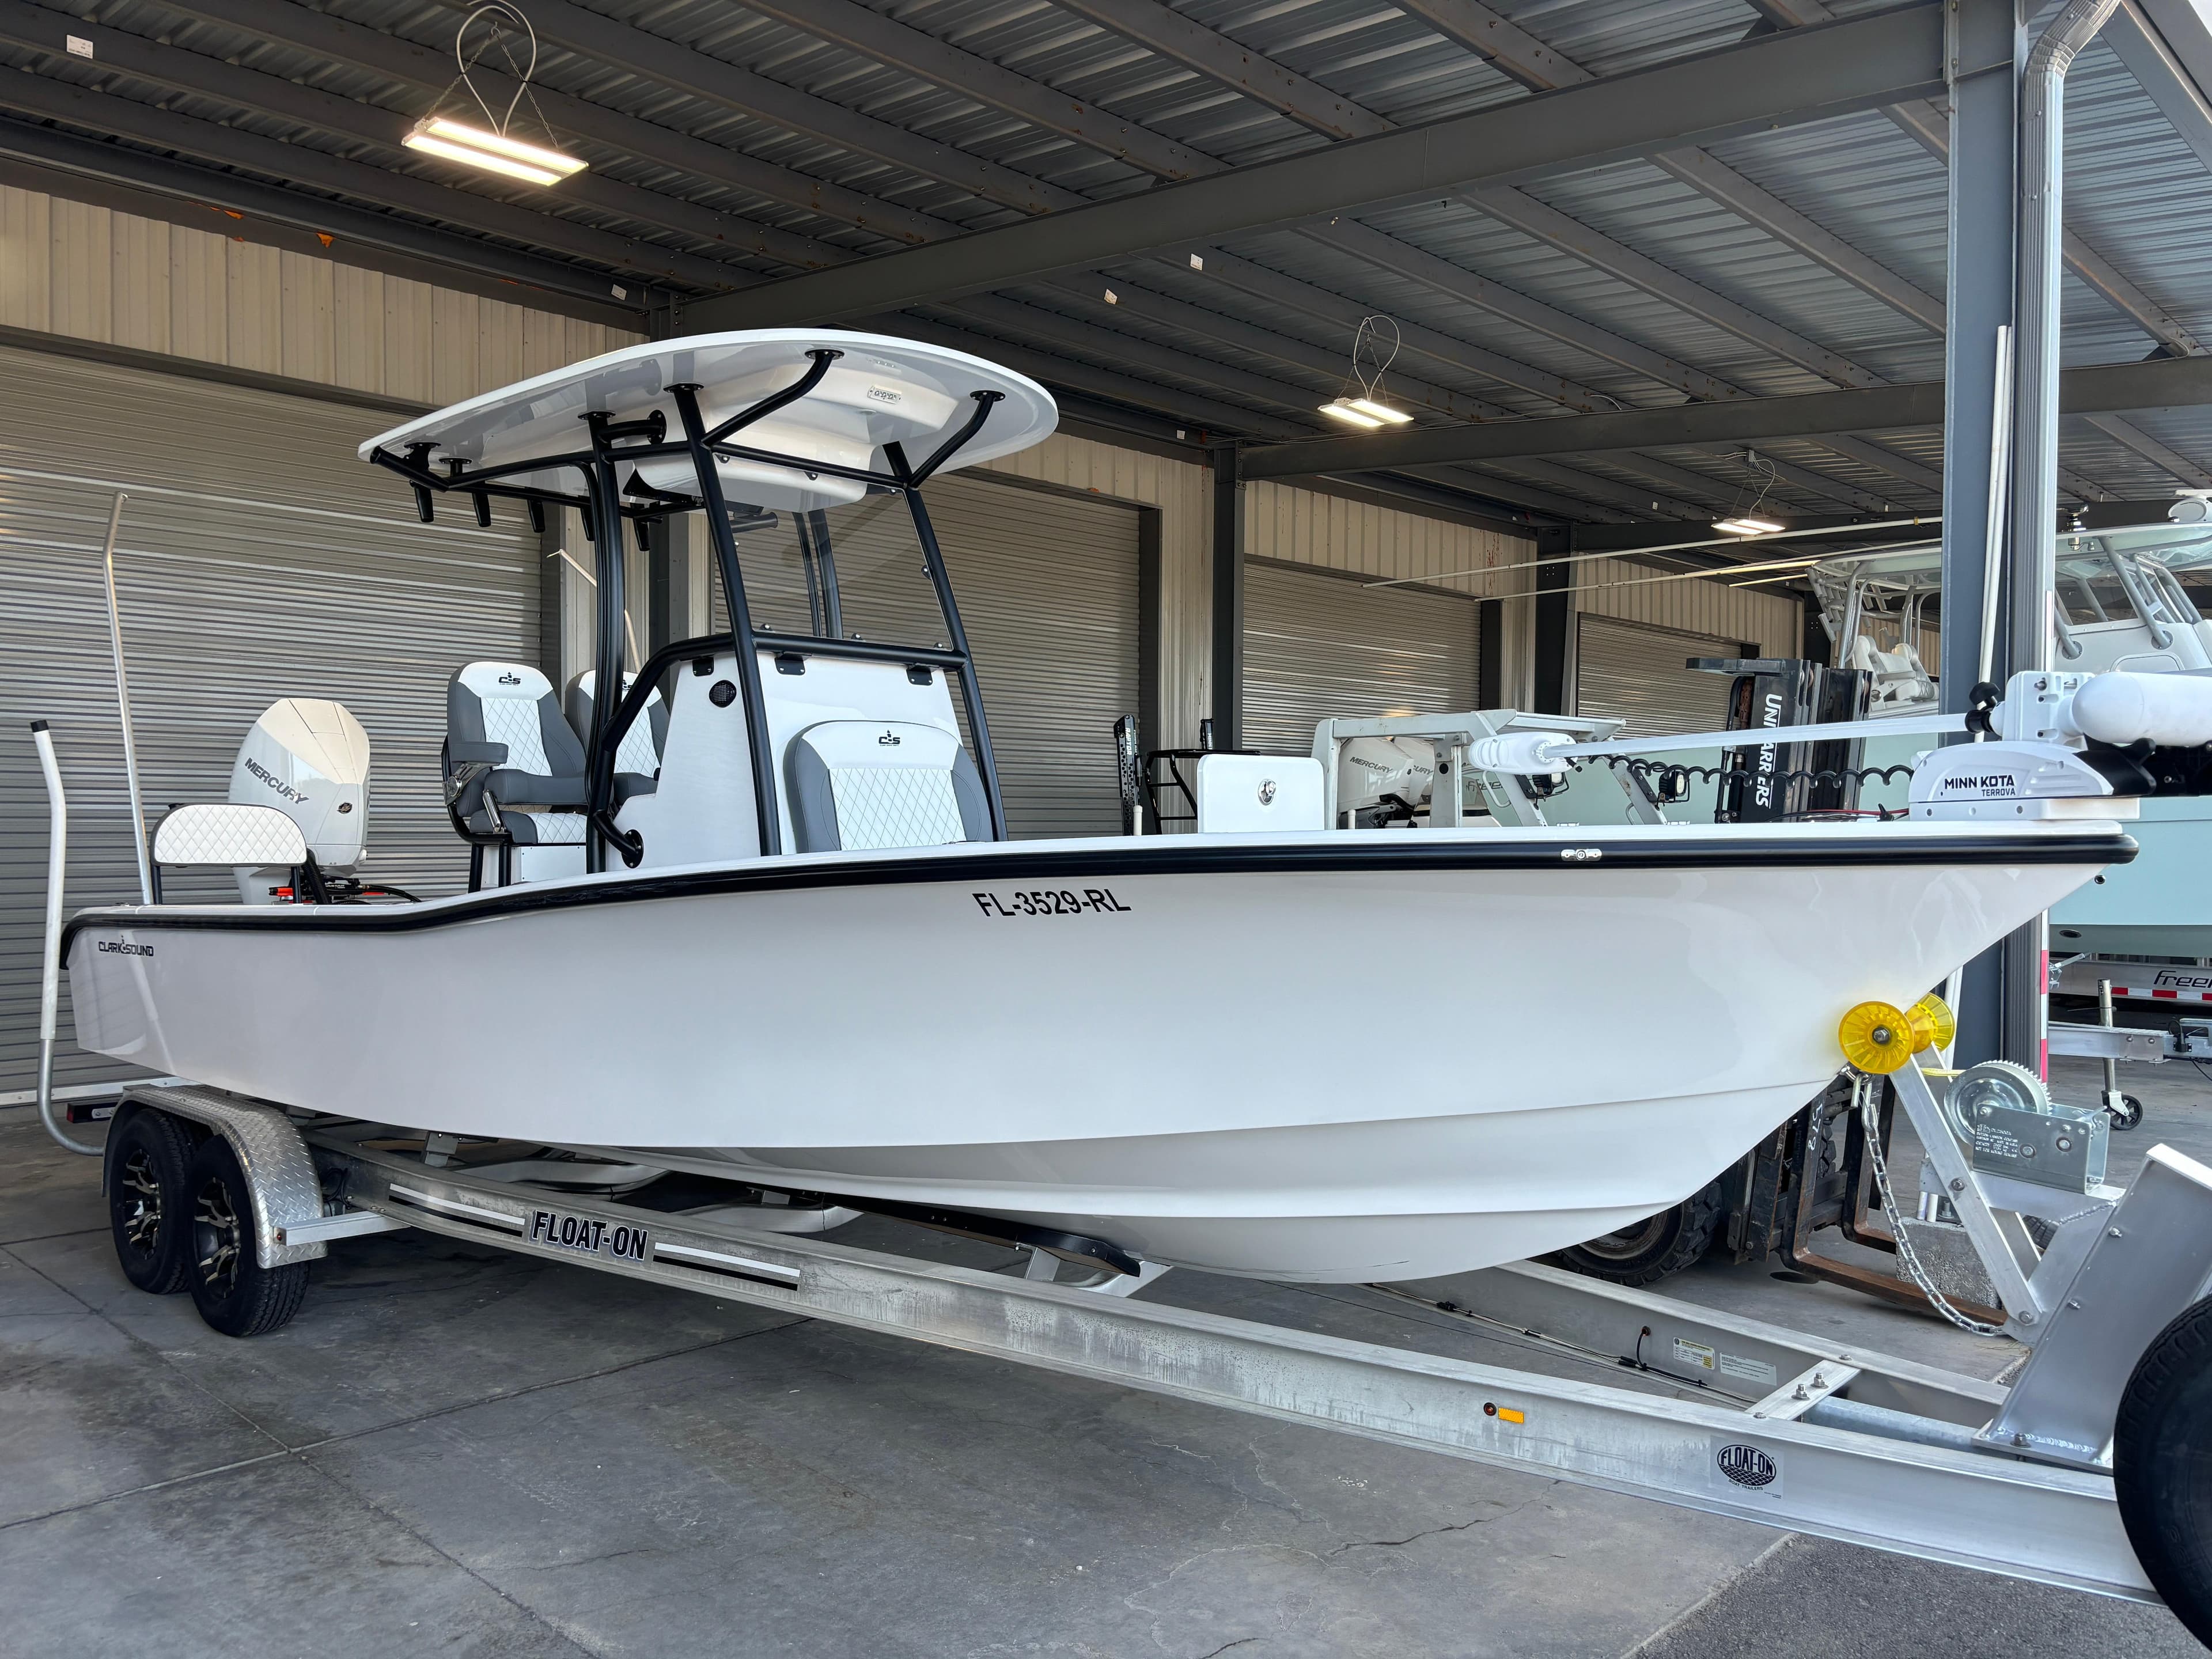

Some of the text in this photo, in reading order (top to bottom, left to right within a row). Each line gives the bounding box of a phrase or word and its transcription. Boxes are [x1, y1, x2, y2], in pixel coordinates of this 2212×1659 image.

[1350, 756, 1393, 774] MERCURY
[244, 757, 309, 804] MERCURY
[1945, 775, 2014, 789] MINN KOTA
[1982, 788, 2016, 797] TERROVA
[972, 889, 1132, 916] FL-3529-RL
[531, 1209, 649, 1261] FLOAT-ON
[1721, 1446, 1774, 1476] FLOAT-ON
[1728, 1479, 1740, 1487] BOAT
